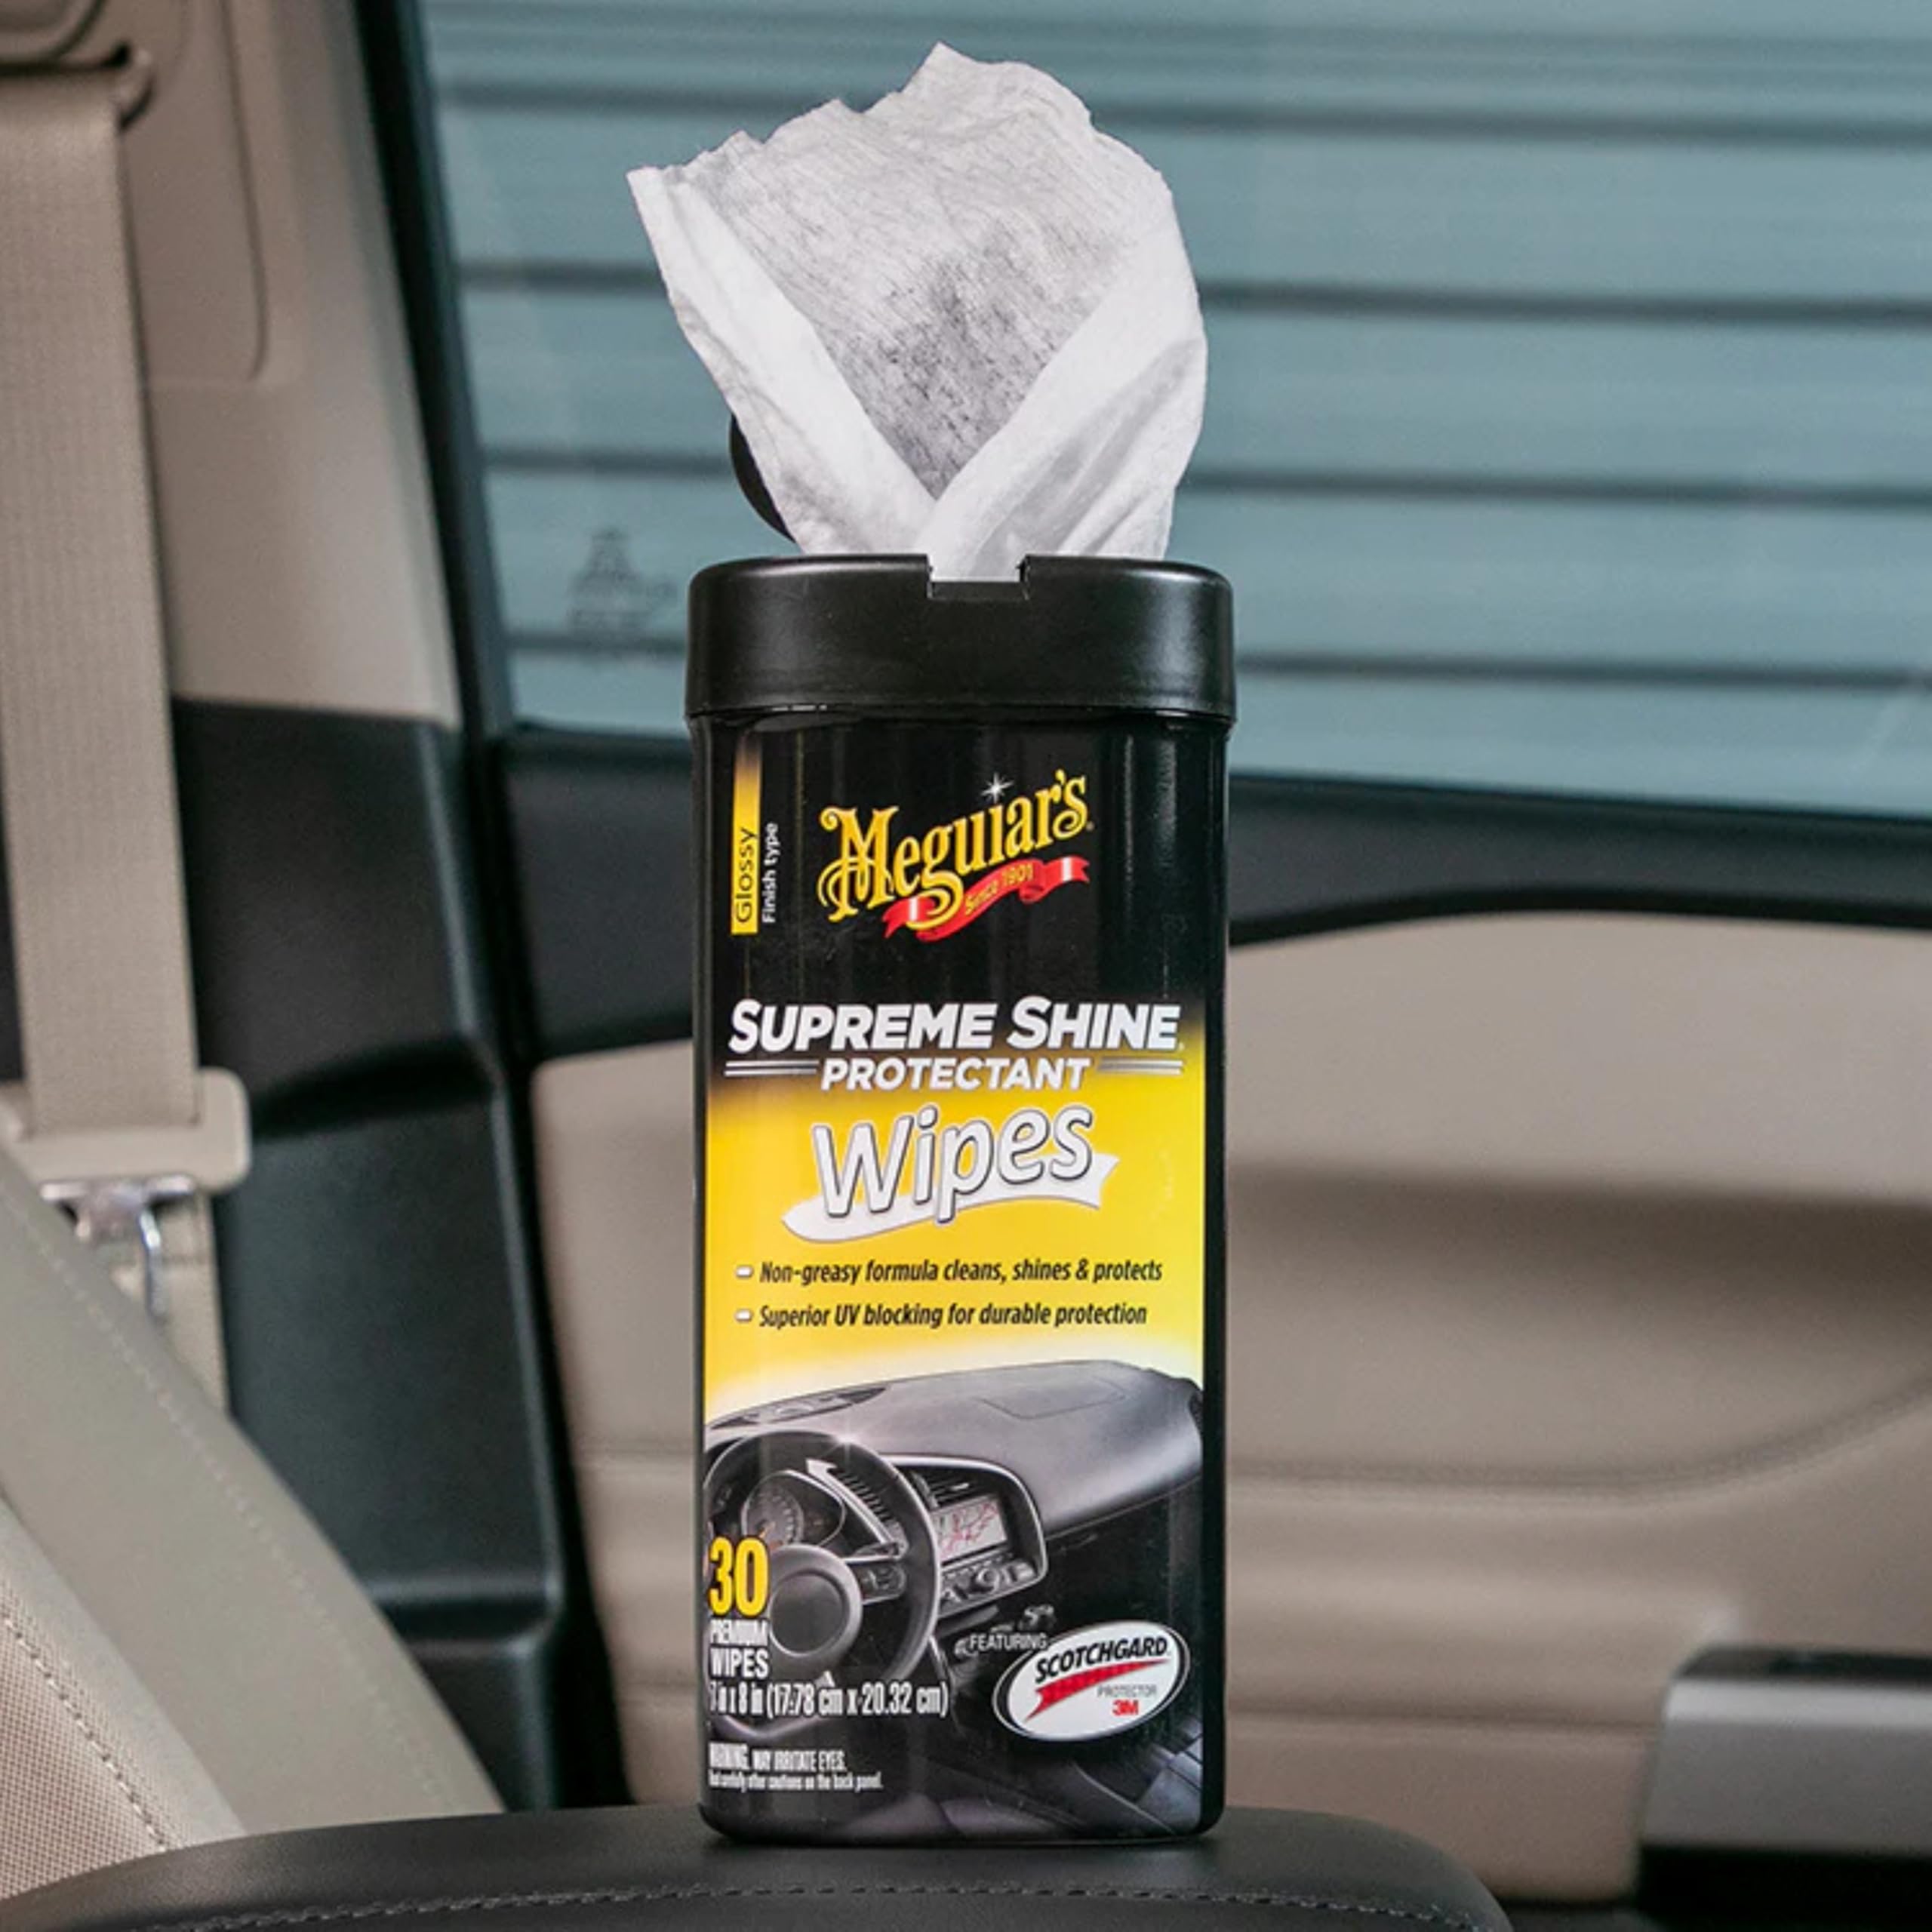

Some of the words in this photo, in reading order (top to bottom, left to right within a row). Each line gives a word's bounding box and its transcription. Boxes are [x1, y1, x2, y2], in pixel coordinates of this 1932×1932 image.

[763, 823, 780, 866] type
[817, 768, 1088, 931] Meguiar's
[735, 827, 759, 923] Glossy
[762, 869, 777, 924] Finish
[728, 998, 998, 1054] SUPREME
[820, 1057, 1093, 1091] PROTECTANT
[810, 1103, 1095, 1225] Wipes
[759, 1260, 860, 1286] Non-greasy
[865, 1260, 938, 1284] formula
[943, 1259, 1008, 1284] cleans,
[1012, 1258, 1072, 1281] shines
[1075, 1259, 1089, 1281] &
[1092, 1259, 1163, 1284] protects
[759, 1304, 830, 1329] Superior
[834, 1304, 862, 1327] UV
[864, 1303, 943, 1329] blocking
[947, 1302, 977, 1326] for
[980, 1302, 1051, 1324] durable
[1054, 1303, 1147, 1328] protection
[708, 1536, 769, 1617] 30
[969, 1632, 1048, 1651] FEATURING
[1035, 1636, 1168, 1684] SCOTCHGARD
[710, 1647, 769, 1680] WIPES
[819, 1685, 844, 1715] cm
[861, 1681, 913, 1715] 20.32
[915, 1681, 949, 1718] cm)
[1112, 1699, 1140, 1717] 3M
